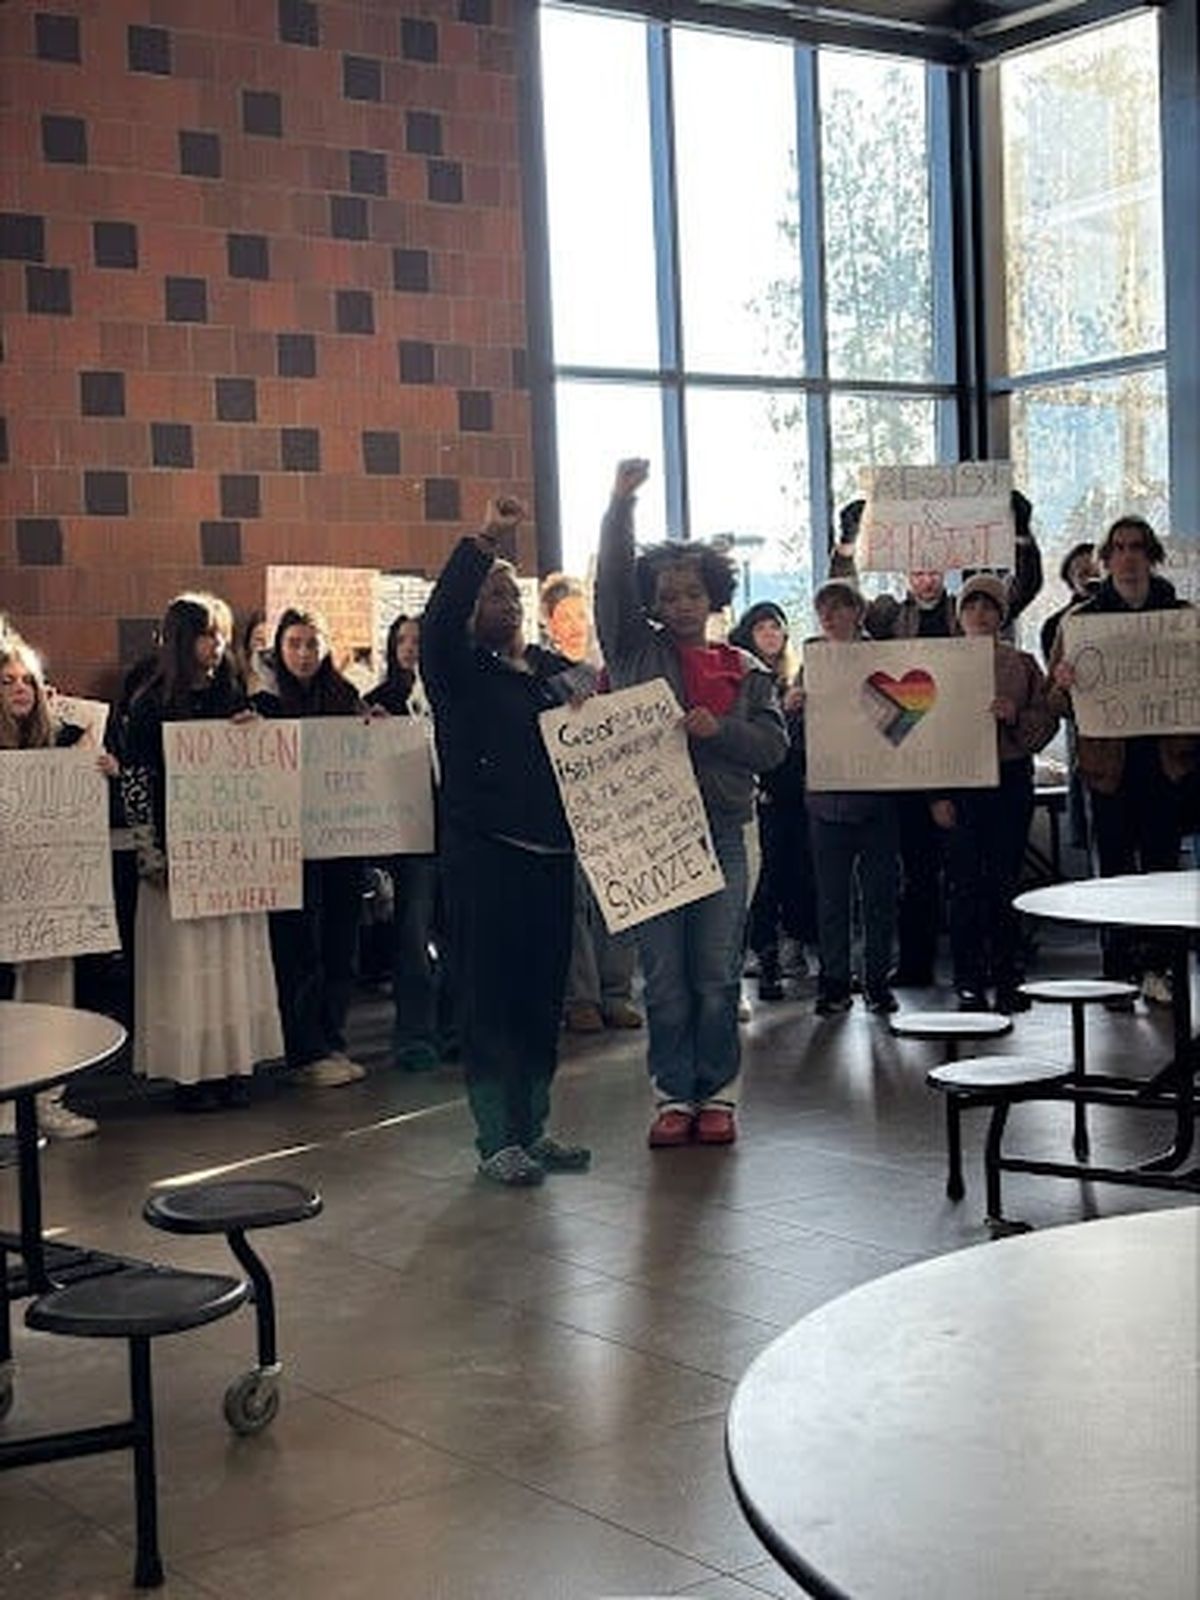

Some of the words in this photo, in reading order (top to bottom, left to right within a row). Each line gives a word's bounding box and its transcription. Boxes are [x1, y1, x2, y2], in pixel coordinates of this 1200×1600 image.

[175, 729, 213, 765] NO
[225, 727, 298, 771] SIGN
[171, 773, 201, 804] IS
[211, 773, 263, 804] BIG
[258, 804, 292, 833] TO
